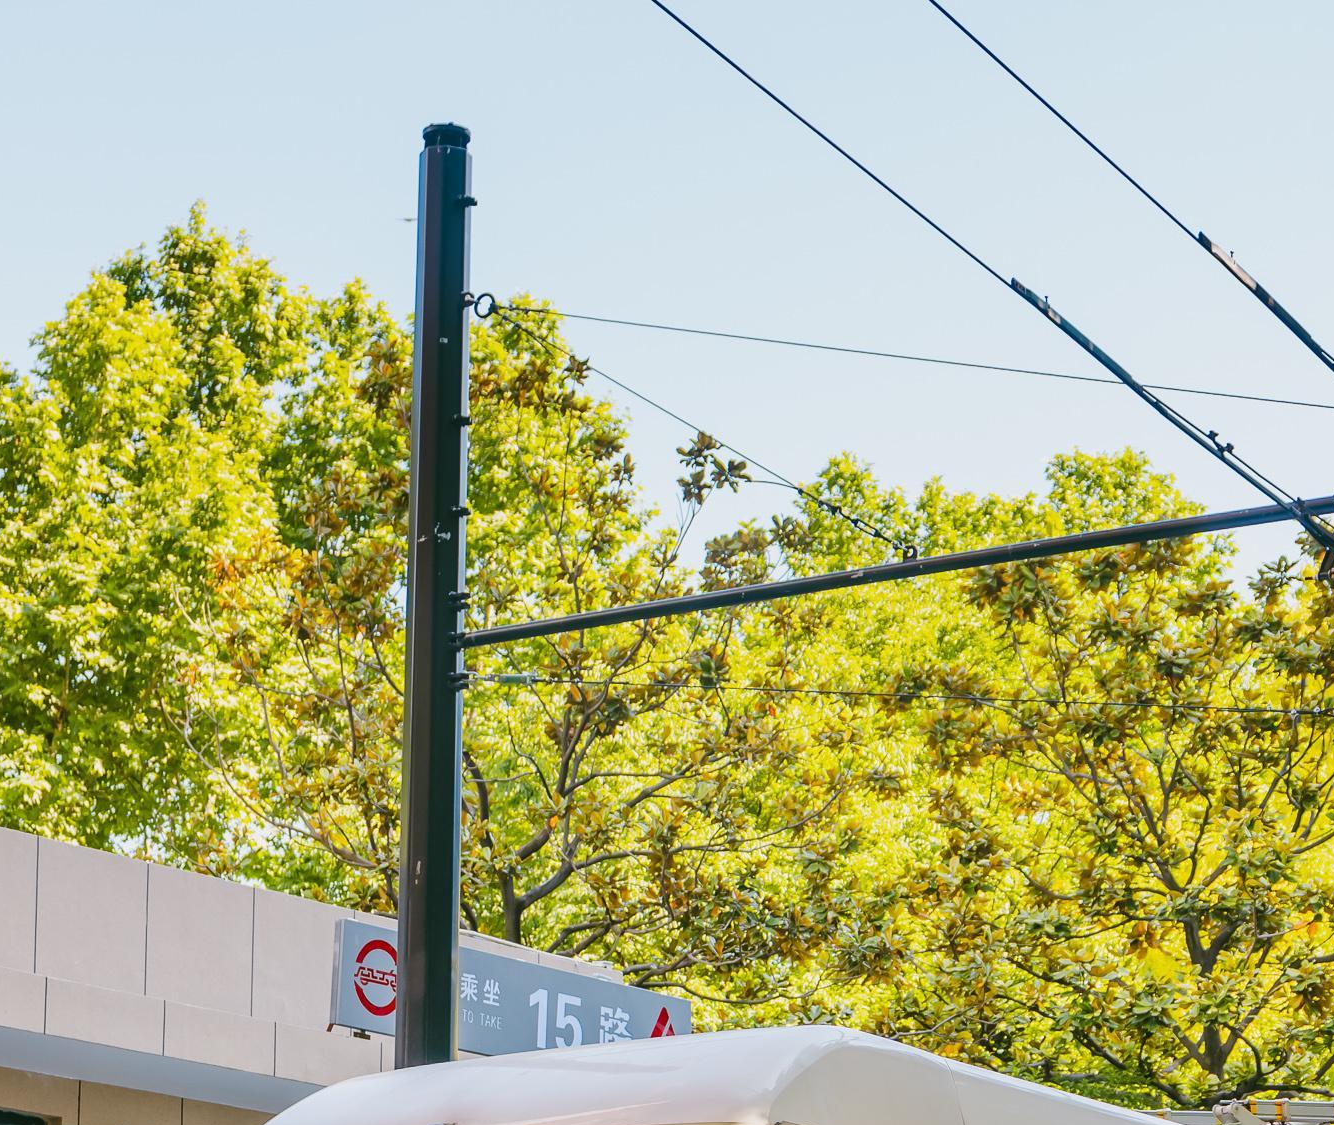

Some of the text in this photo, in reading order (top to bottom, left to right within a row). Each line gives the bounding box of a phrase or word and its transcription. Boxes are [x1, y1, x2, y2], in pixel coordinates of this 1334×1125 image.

[460, 973, 501, 1007] 乘坐
[462, 1009, 502, 1030] TO TAKE
[529, 988, 634, 1049] 15 路
